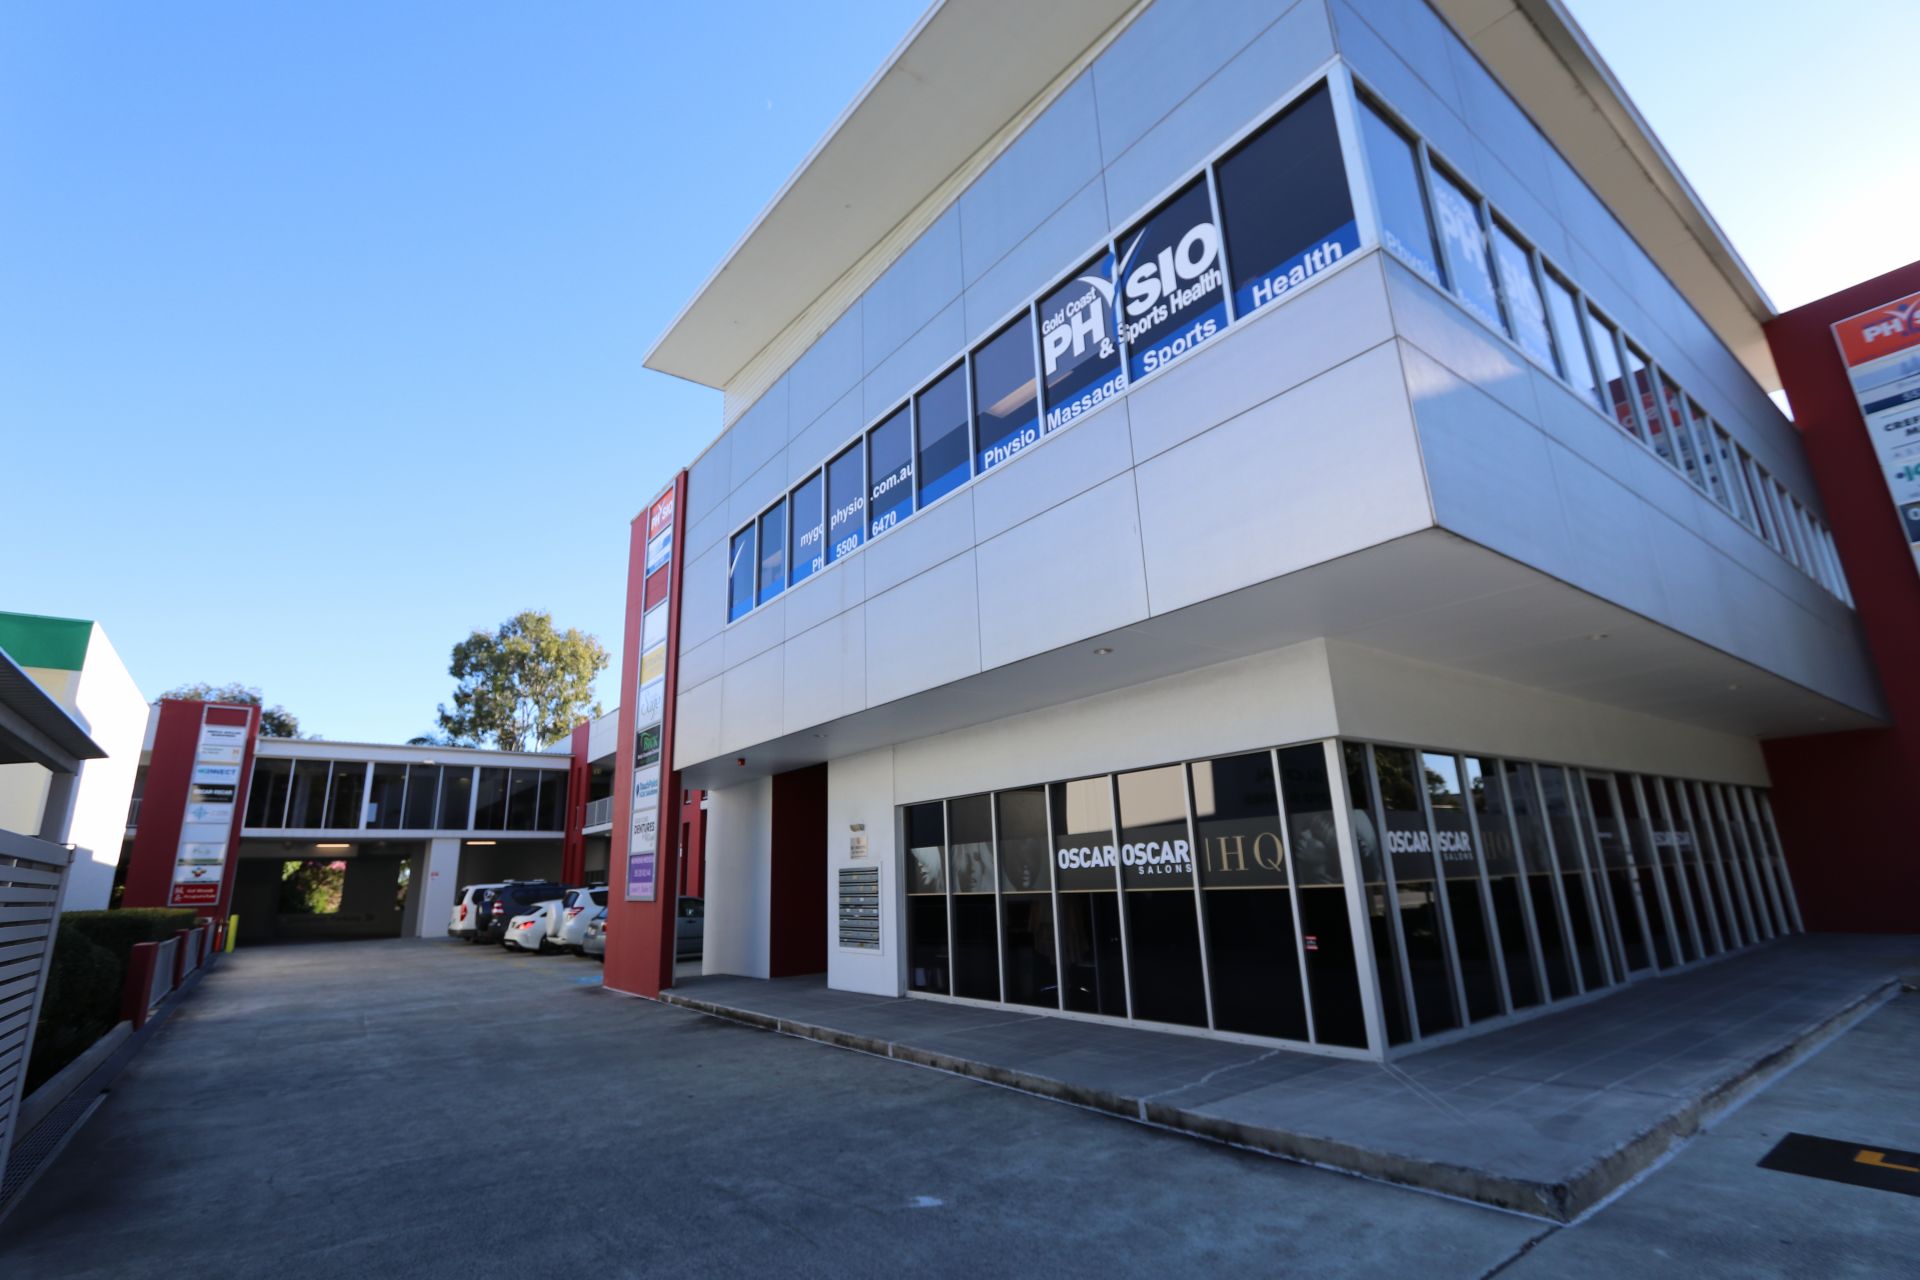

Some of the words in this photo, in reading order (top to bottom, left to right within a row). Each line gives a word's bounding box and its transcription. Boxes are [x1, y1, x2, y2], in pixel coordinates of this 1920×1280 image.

[1042, 308, 1064, 335] Gold
[1066, 286, 1097, 317] Coast
[1099, 337, 1115, 359] &
[1117, 304, 1168, 345] Sports
[1169, 268, 1222, 314] Health
[984, 429, 1035, 469] Physio
[1047, 373, 1126, 431] Massage
[1143, 319, 1217, 372] Sports
[1252, 240, 1343, 308] Health
[836, 534, 858, 558] 5500
[872, 510, 897, 537] 6470
[1058, 845, 1117, 869] OSCAR
[1122, 840, 1191, 866] OSCAR
[1217, 832, 1284, 872] HQ
[1388, 830, 1431, 853] OSCAR
[1438, 831, 1472, 853] SCAR
[1138, 864, 1193, 875] SALONS
